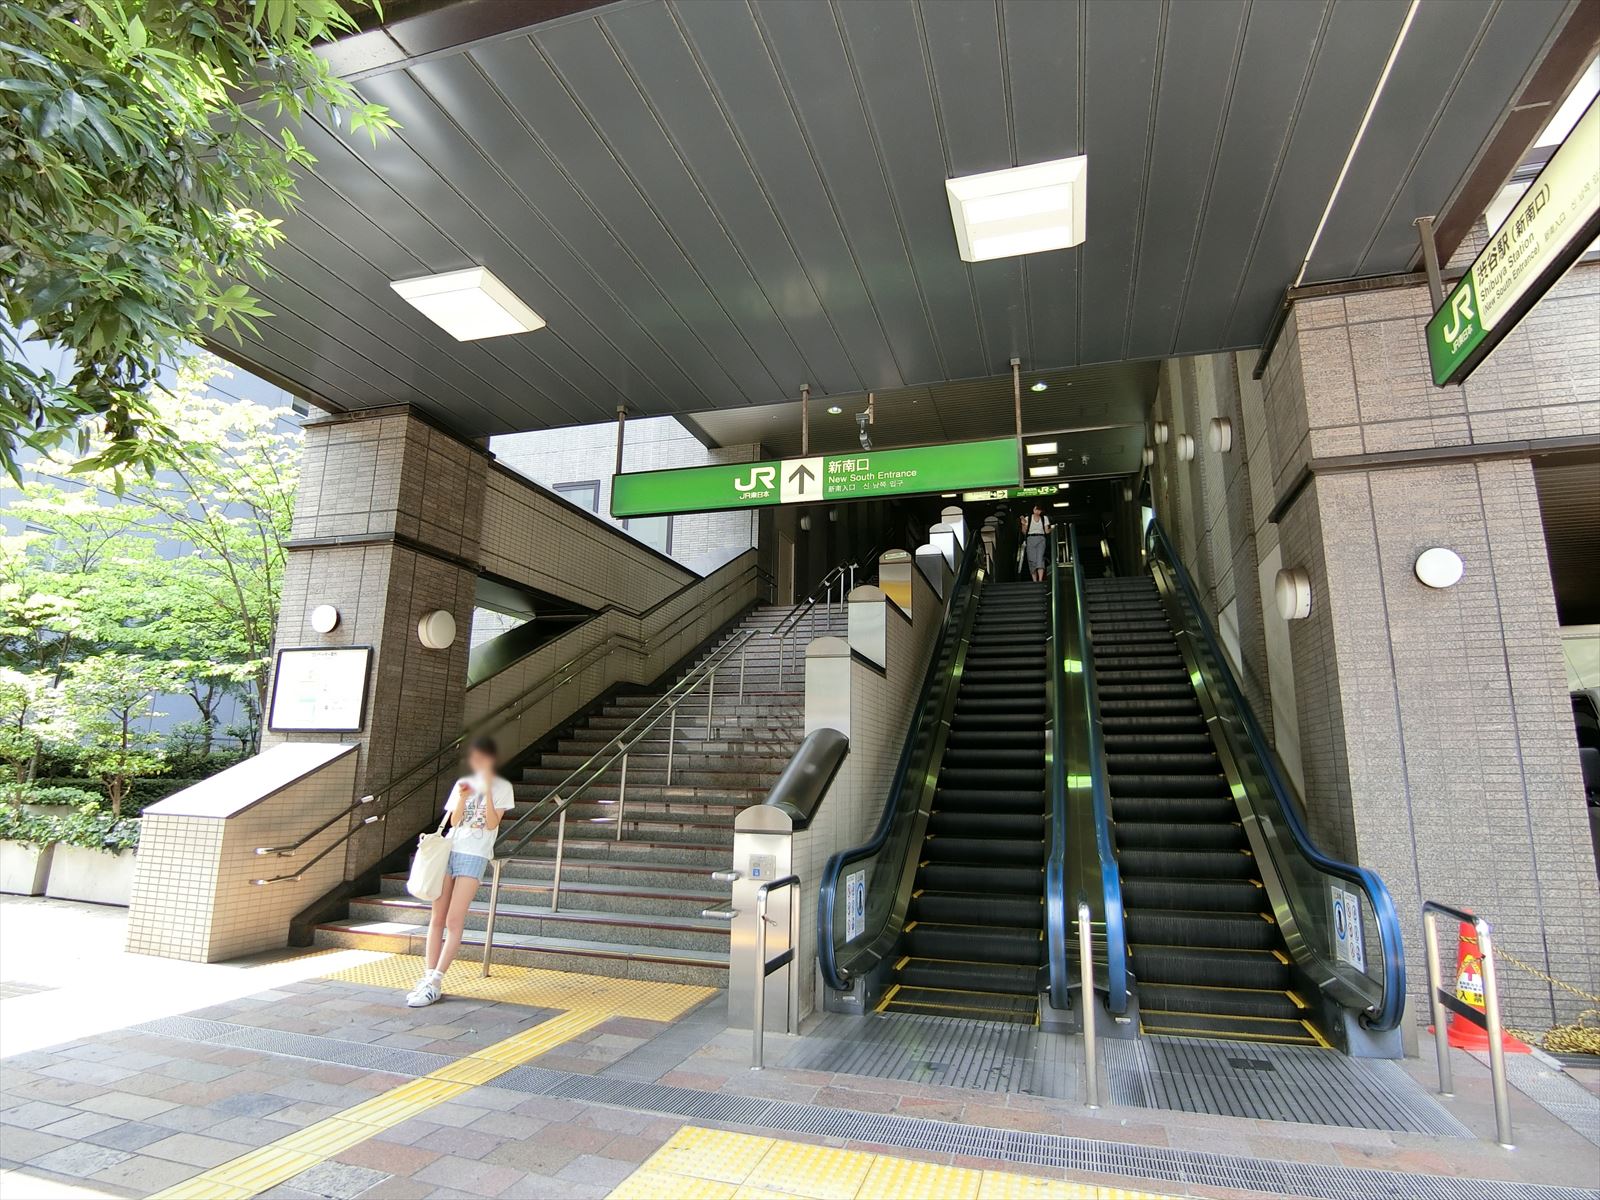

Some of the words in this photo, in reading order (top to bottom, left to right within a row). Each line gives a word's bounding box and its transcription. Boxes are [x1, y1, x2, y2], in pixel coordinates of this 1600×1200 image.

[1480, 265, 1508, 302] Shibuya
[1507, 232, 1535, 269] Station
[1496, 276, 1512, 301] South
[1511, 242, 1541, 281] Entrance)
[1443, 284, 1475, 343] JR
[828, 458, 870, 474] 新南口
[734, 466, 776, 492] JR
[828, 475, 848, 484] New
[849, 472, 875, 482] South
[877, 470, 917, 480] Entrance
[739, 491, 770, 500] JR東日本
[828, 483, 856, 493] 新南入口
